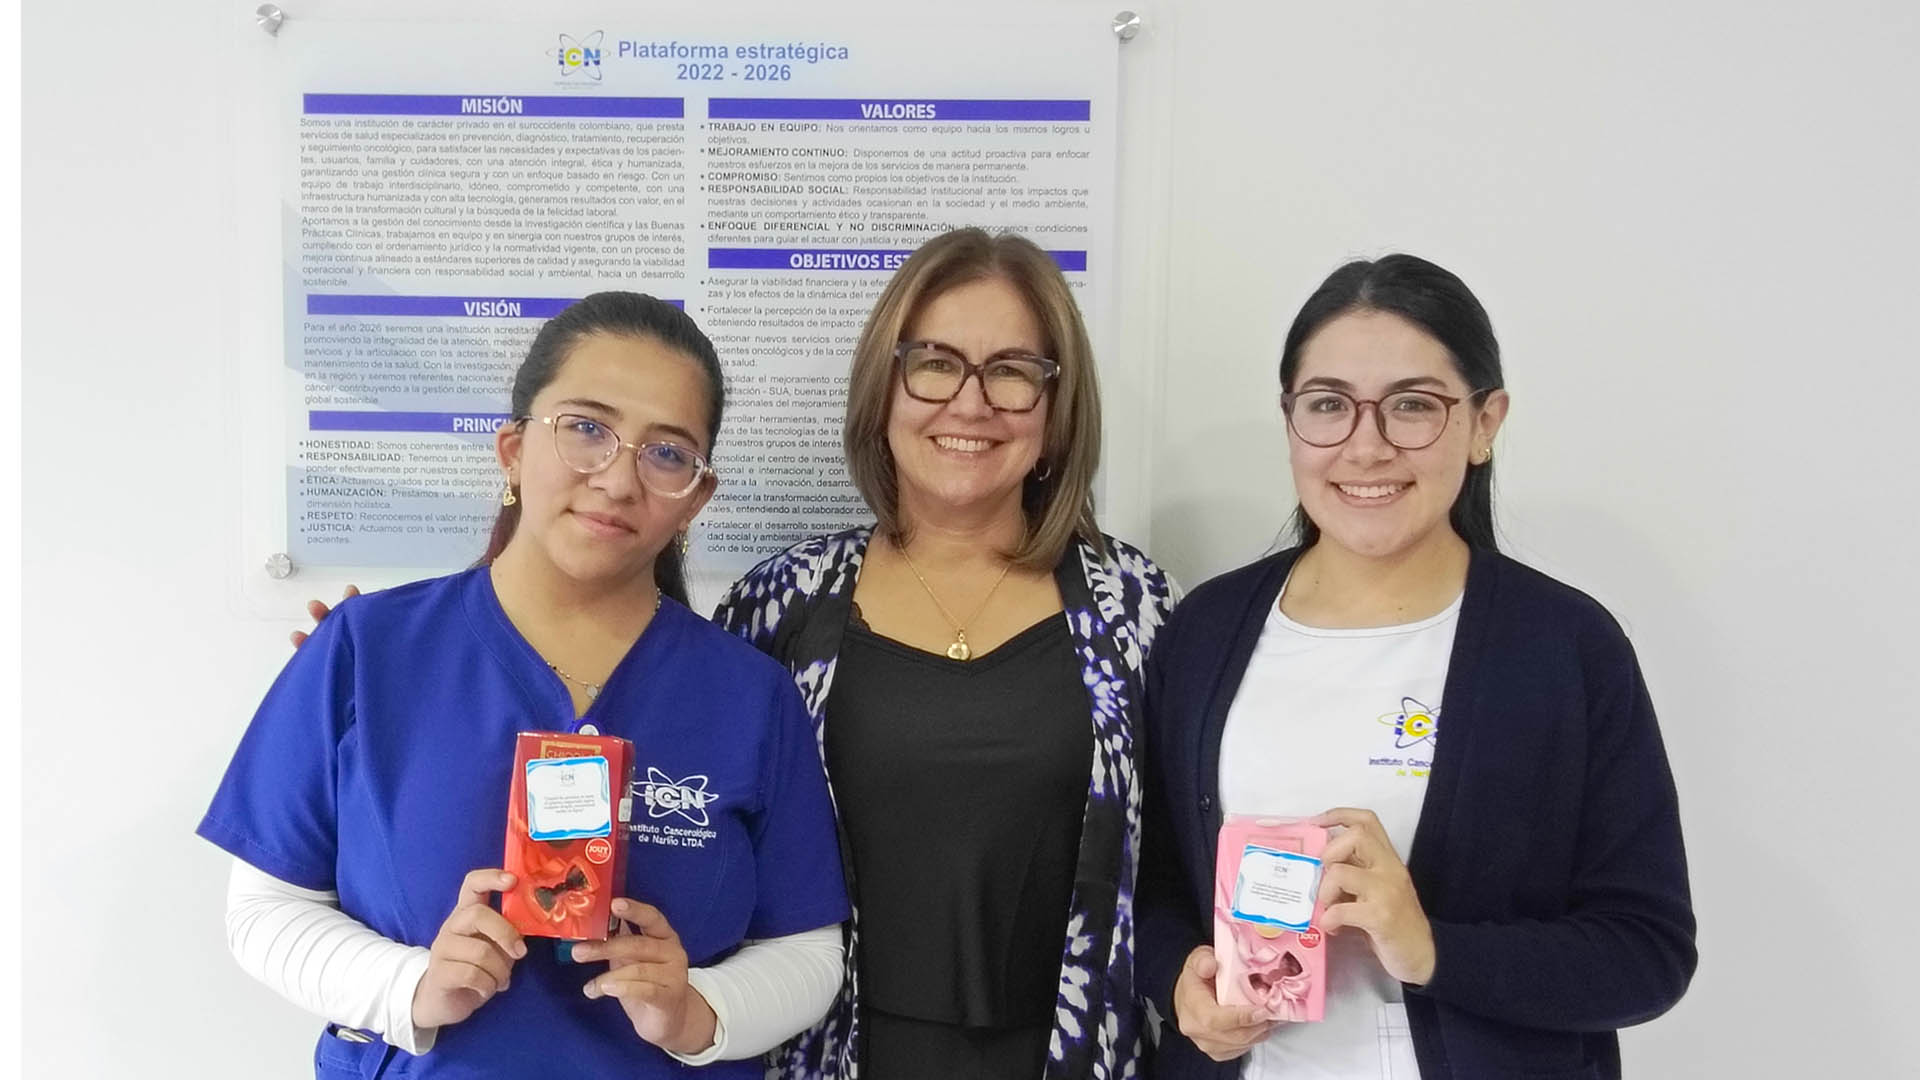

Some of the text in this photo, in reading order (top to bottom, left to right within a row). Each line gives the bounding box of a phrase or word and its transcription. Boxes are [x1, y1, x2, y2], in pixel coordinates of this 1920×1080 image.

[618, 40, 849, 64] Plataforma estratégica
[677, 63, 724, 80] 2022
[744, 64, 792, 81] 2026
[462, 96, 523, 114] MISIÓN
[860, 104, 936, 119] VALORES
[790, 254, 880, 268] OBJETIVOS
[464, 300, 520, 316] VISIÓN
